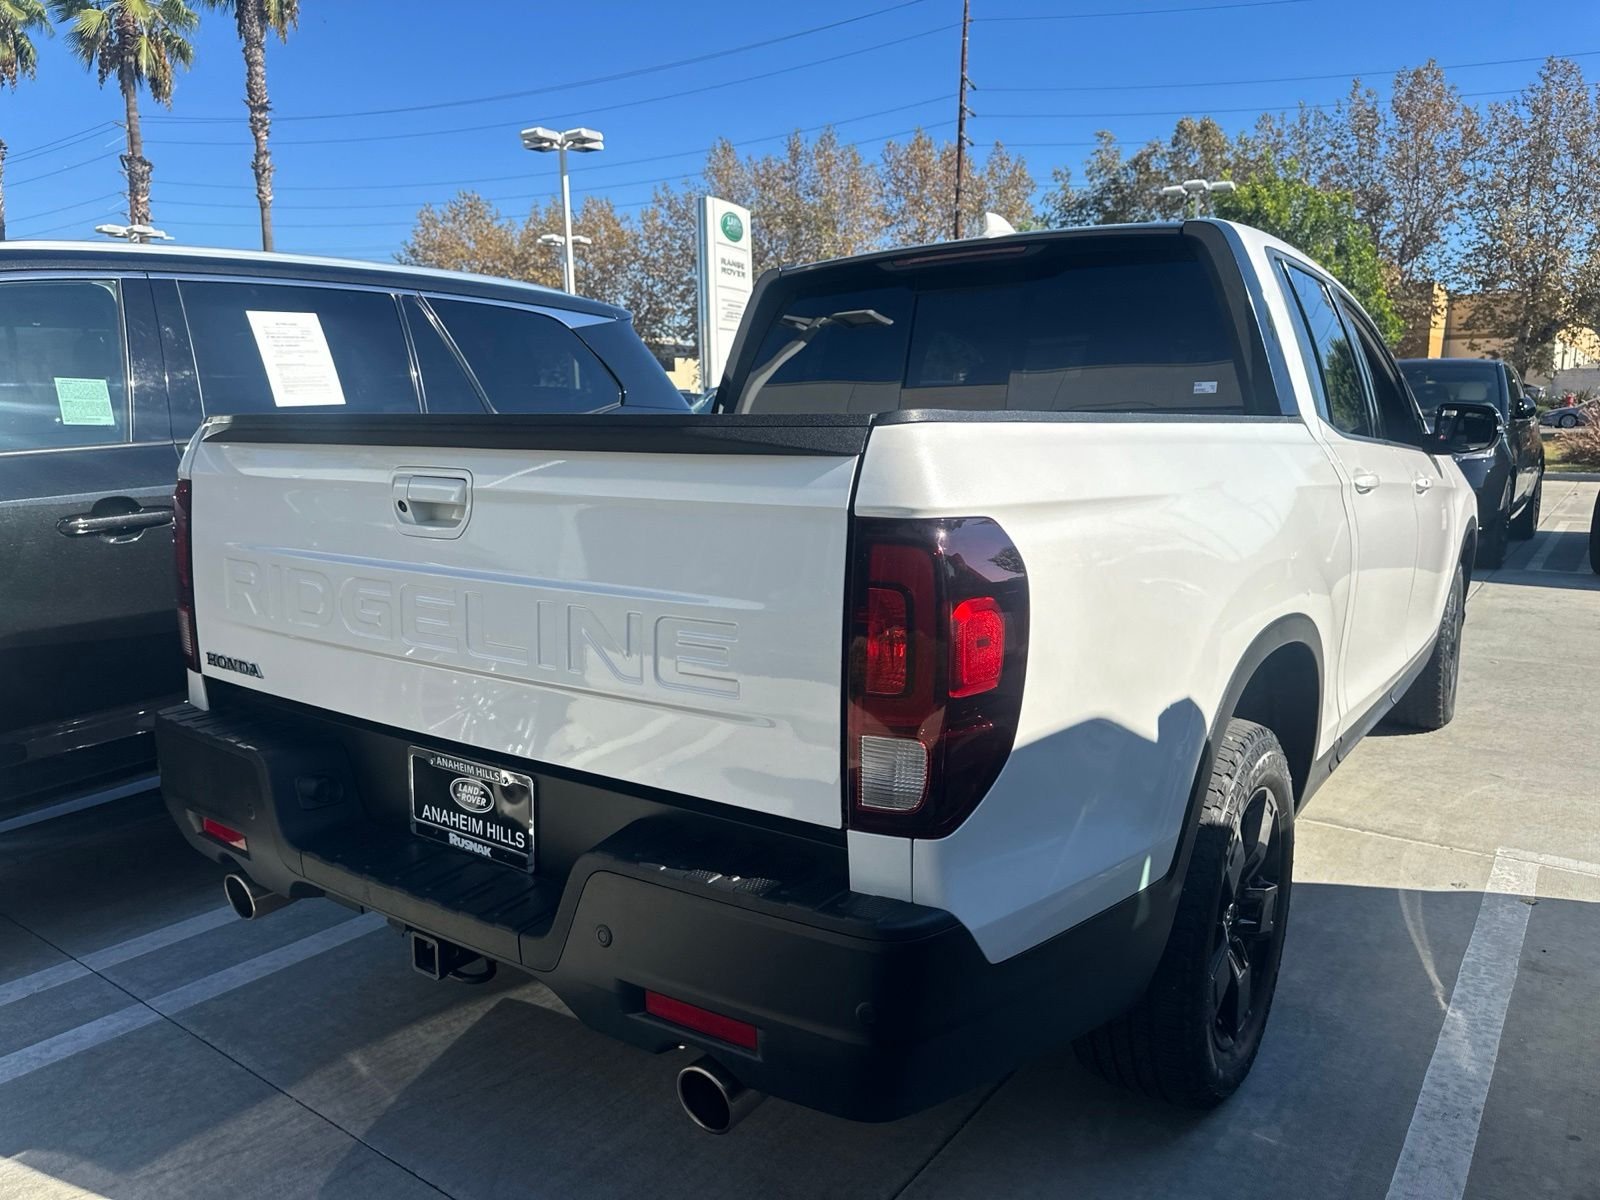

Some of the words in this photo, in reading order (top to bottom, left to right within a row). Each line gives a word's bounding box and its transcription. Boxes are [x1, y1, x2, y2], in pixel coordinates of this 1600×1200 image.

[721, 266, 746, 279] ROVER
[223, 556, 741, 700] RIDGELINE
[206, 652, 264, 679] HONDA
[436, 756, 475, 775] ANAHEIM
[475, 767, 500, 782] HILLS
[458, 783, 479, 795] LAND
[461, 794, 487, 807] ROVER
[422, 804, 483, 836] ANAHEIM
[487, 822, 525, 849] HILLS
[448, 832, 492, 858] RUSNAK
